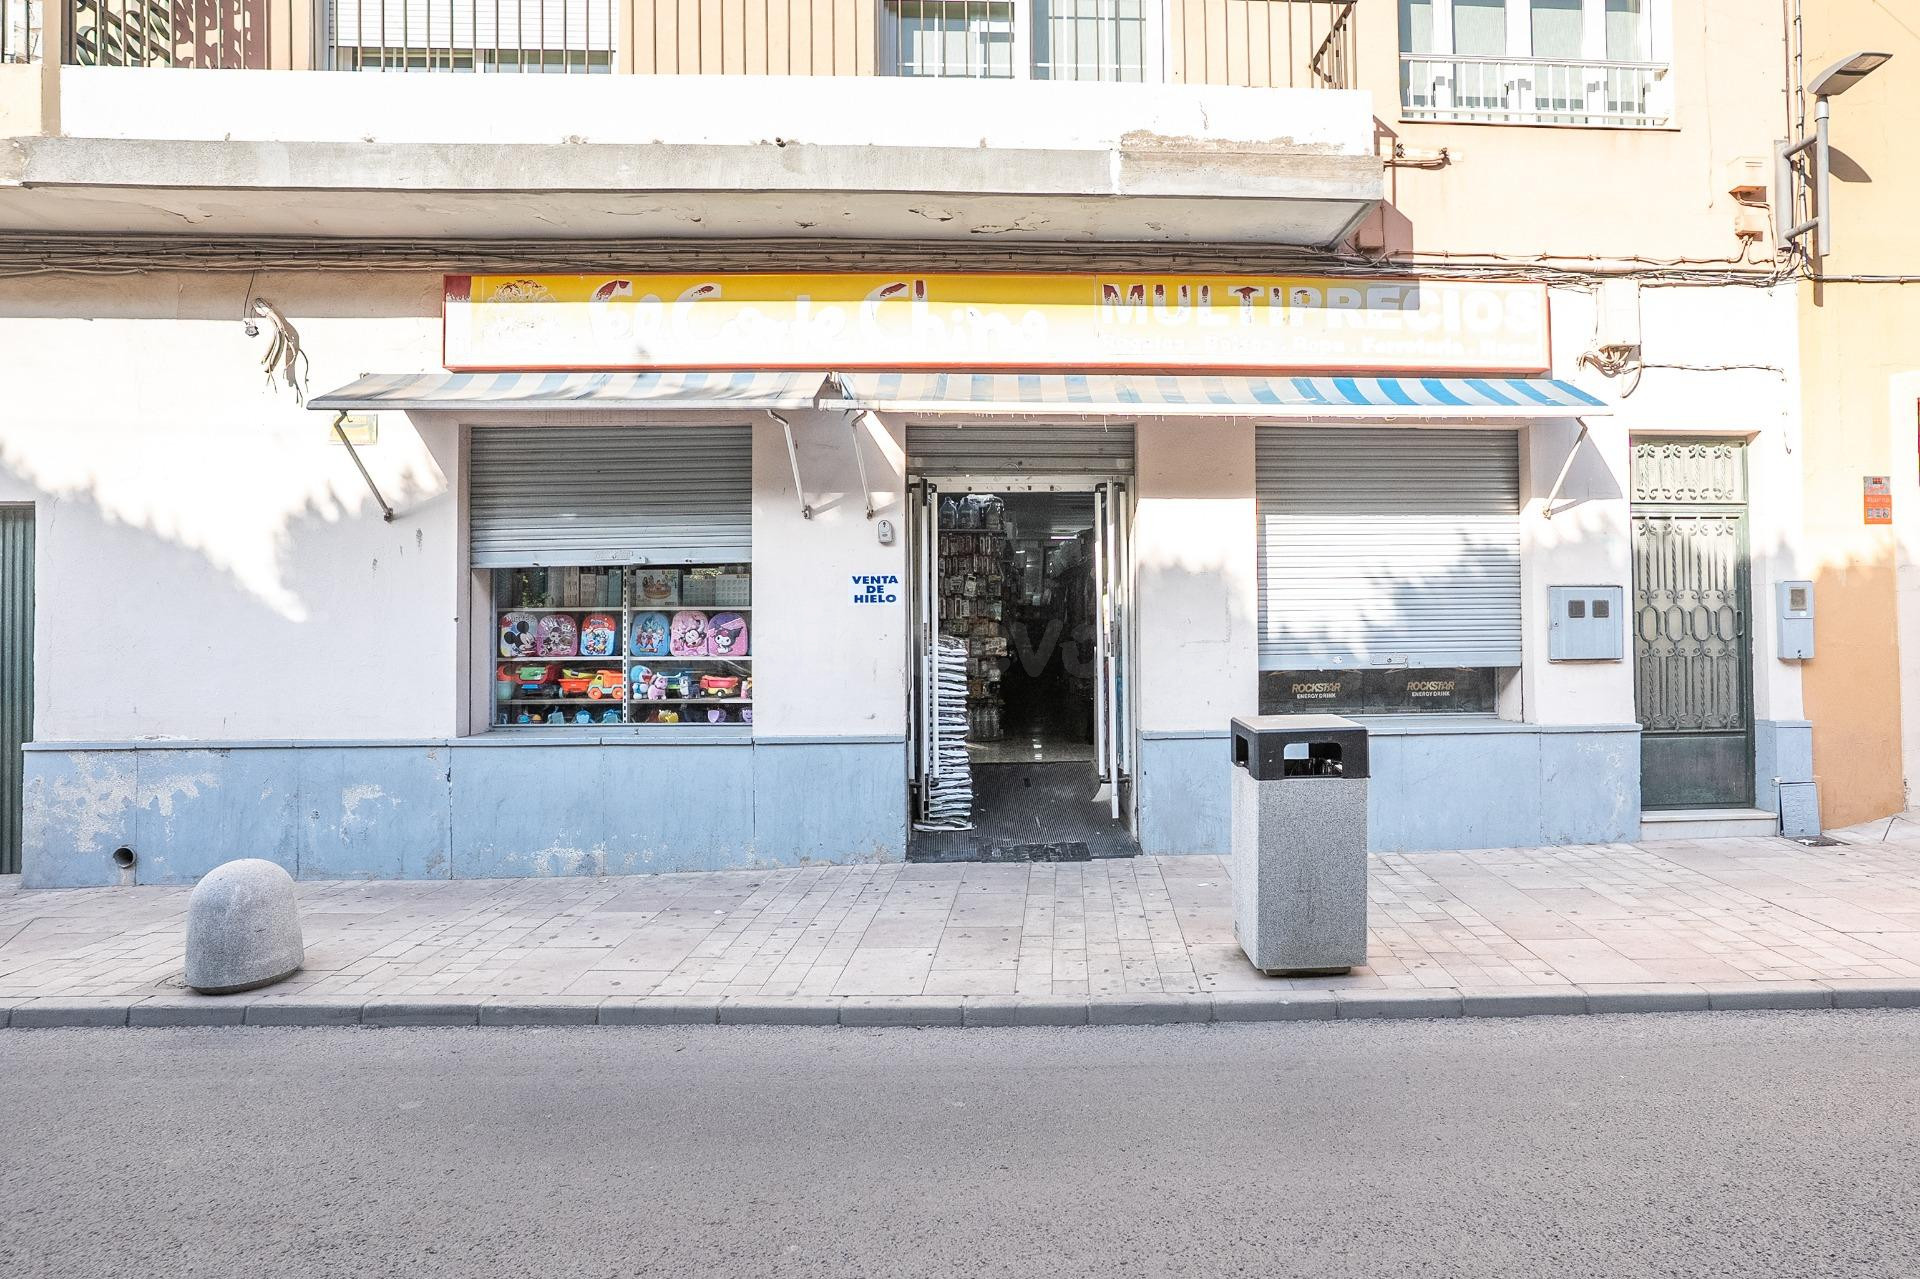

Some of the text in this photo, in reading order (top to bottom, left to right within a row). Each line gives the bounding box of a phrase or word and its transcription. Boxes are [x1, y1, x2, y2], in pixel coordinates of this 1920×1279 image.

[1101, 283, 1538, 334] MULTIPRECIOS
[852, 575, 899, 584] VENTA
[866, 585, 885, 594] DE
[854, 594, 897, 603] HIELO
[1292, 682, 1341, 693] ROCKSTAR
[1407, 681, 1455, 691] ROCKSTAR
